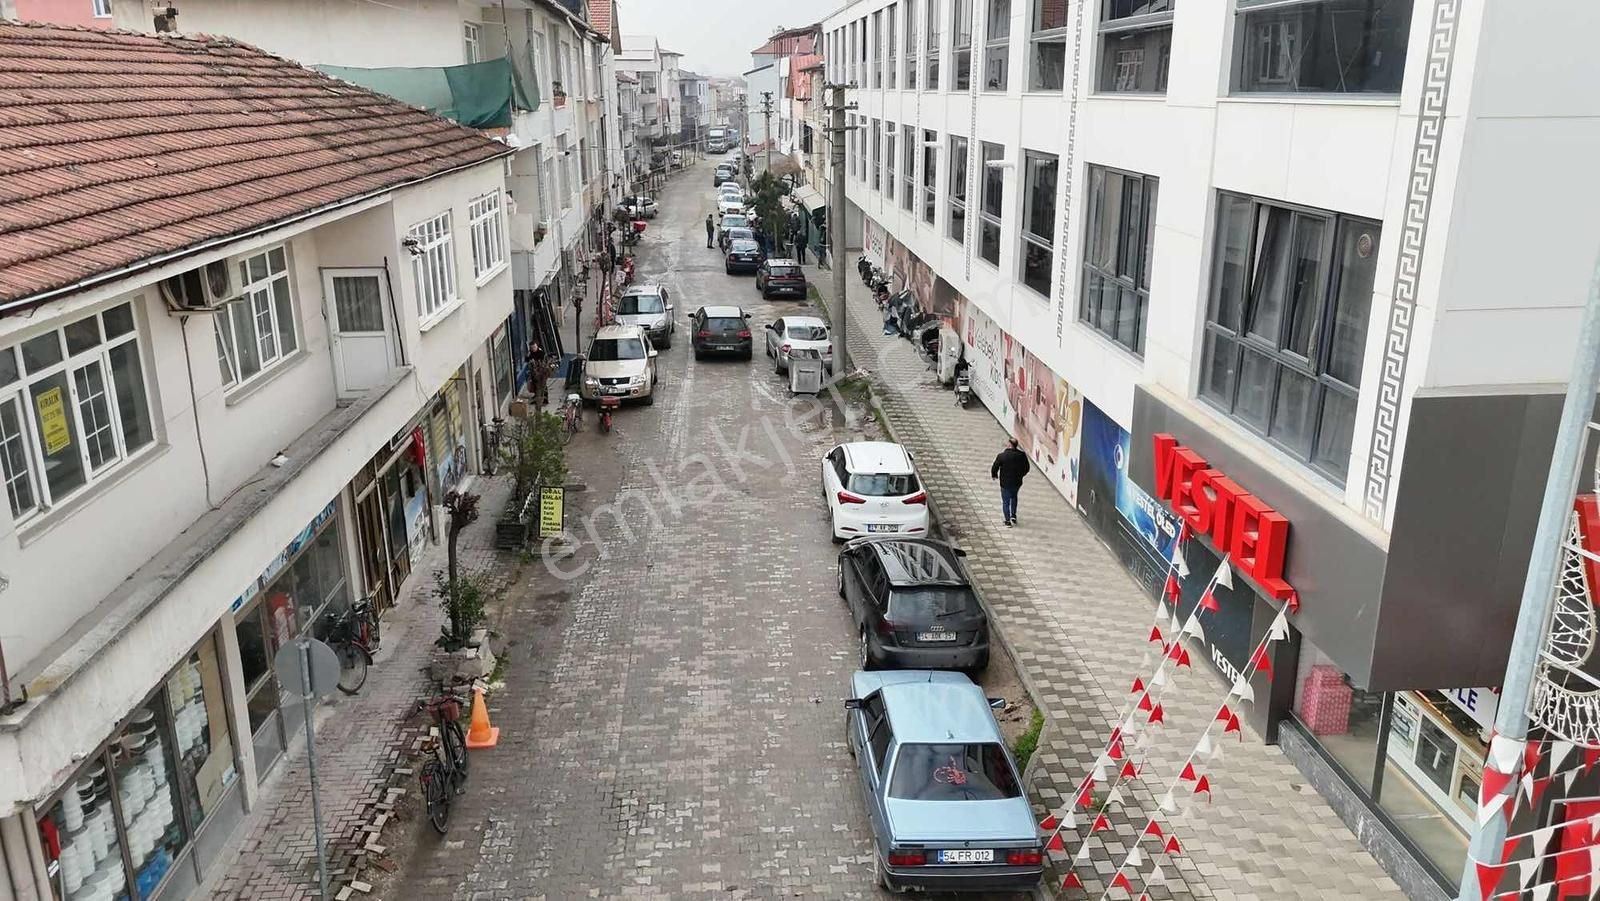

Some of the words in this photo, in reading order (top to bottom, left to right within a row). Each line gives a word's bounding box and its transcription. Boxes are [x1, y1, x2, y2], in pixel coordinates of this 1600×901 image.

[1153, 433, 1293, 599] VESTEL
[1211, 643, 1241, 685] VESTE
[943, 851, 955, 861] 54
[958, 851, 972, 861] FR
[974, 850, 990, 861] 012
